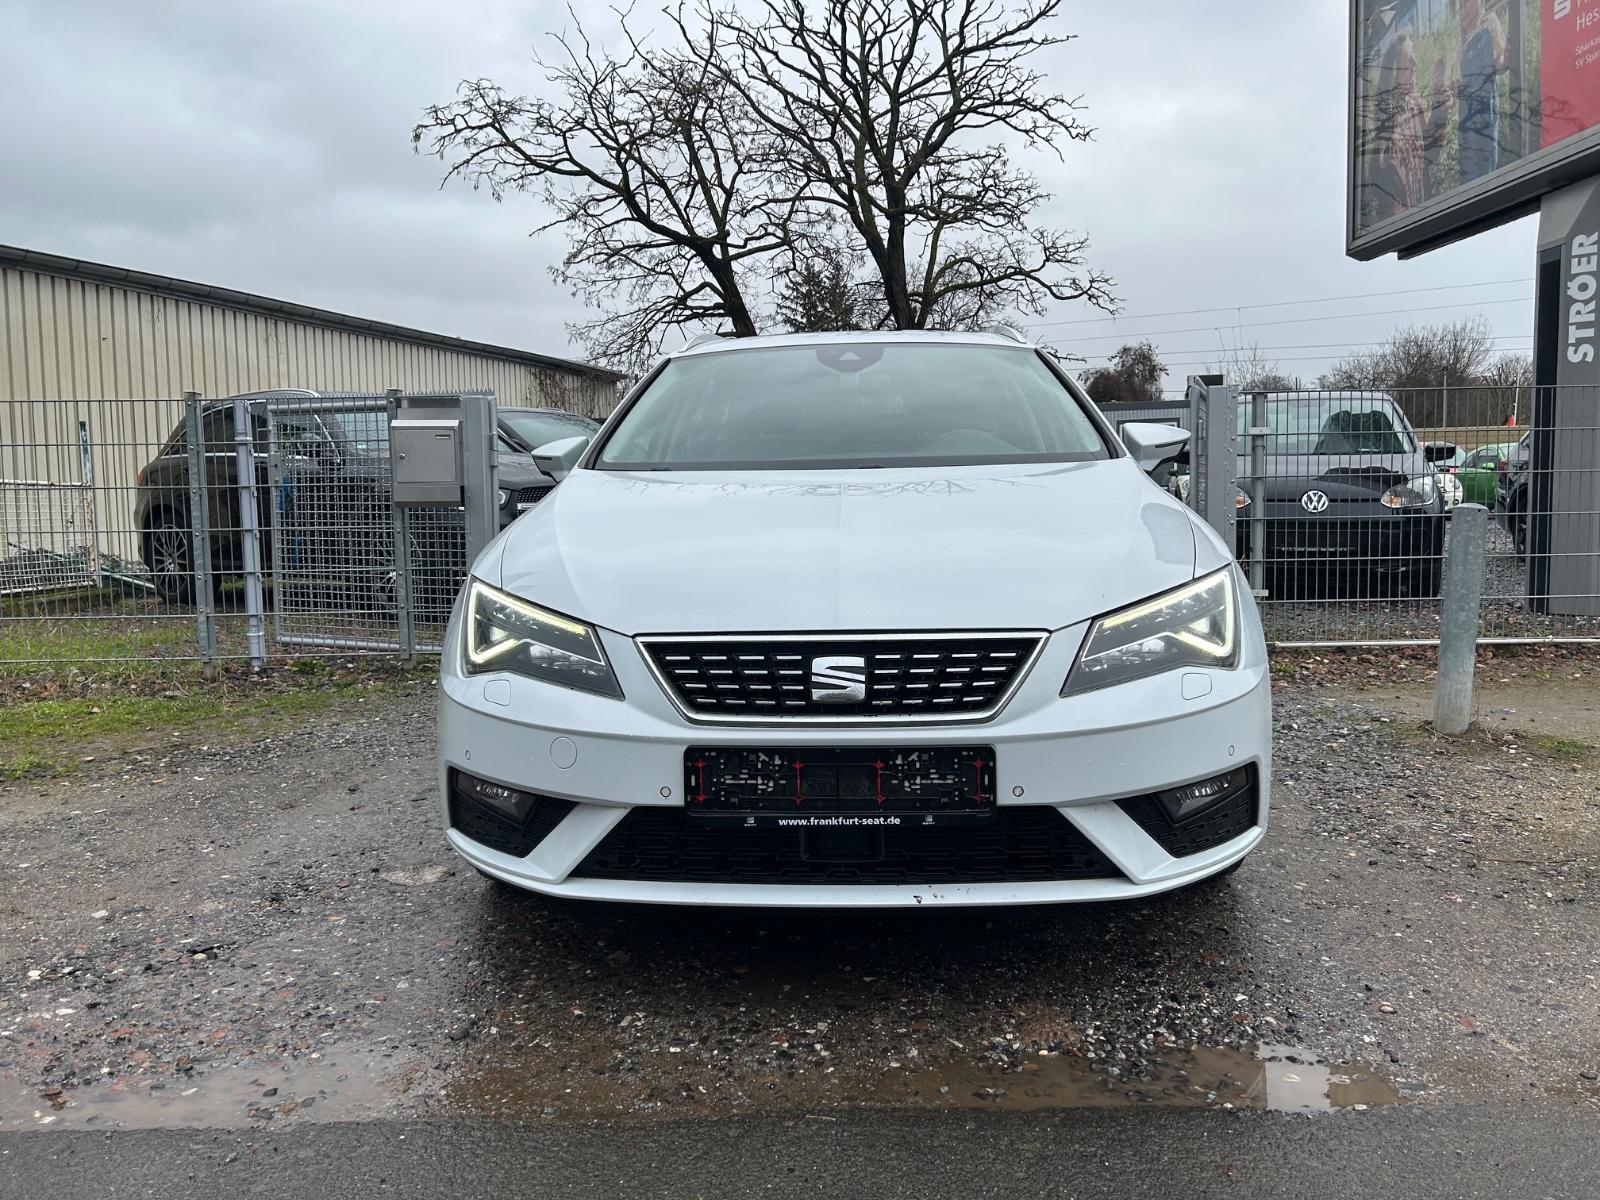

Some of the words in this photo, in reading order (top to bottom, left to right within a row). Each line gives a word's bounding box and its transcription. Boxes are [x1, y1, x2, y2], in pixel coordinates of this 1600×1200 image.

[1576, 8, 1600, 31] Hes
[1567, 231, 1599, 363] STRÖER
[778, 816, 901, 827] www.frankfurt-seat.de
